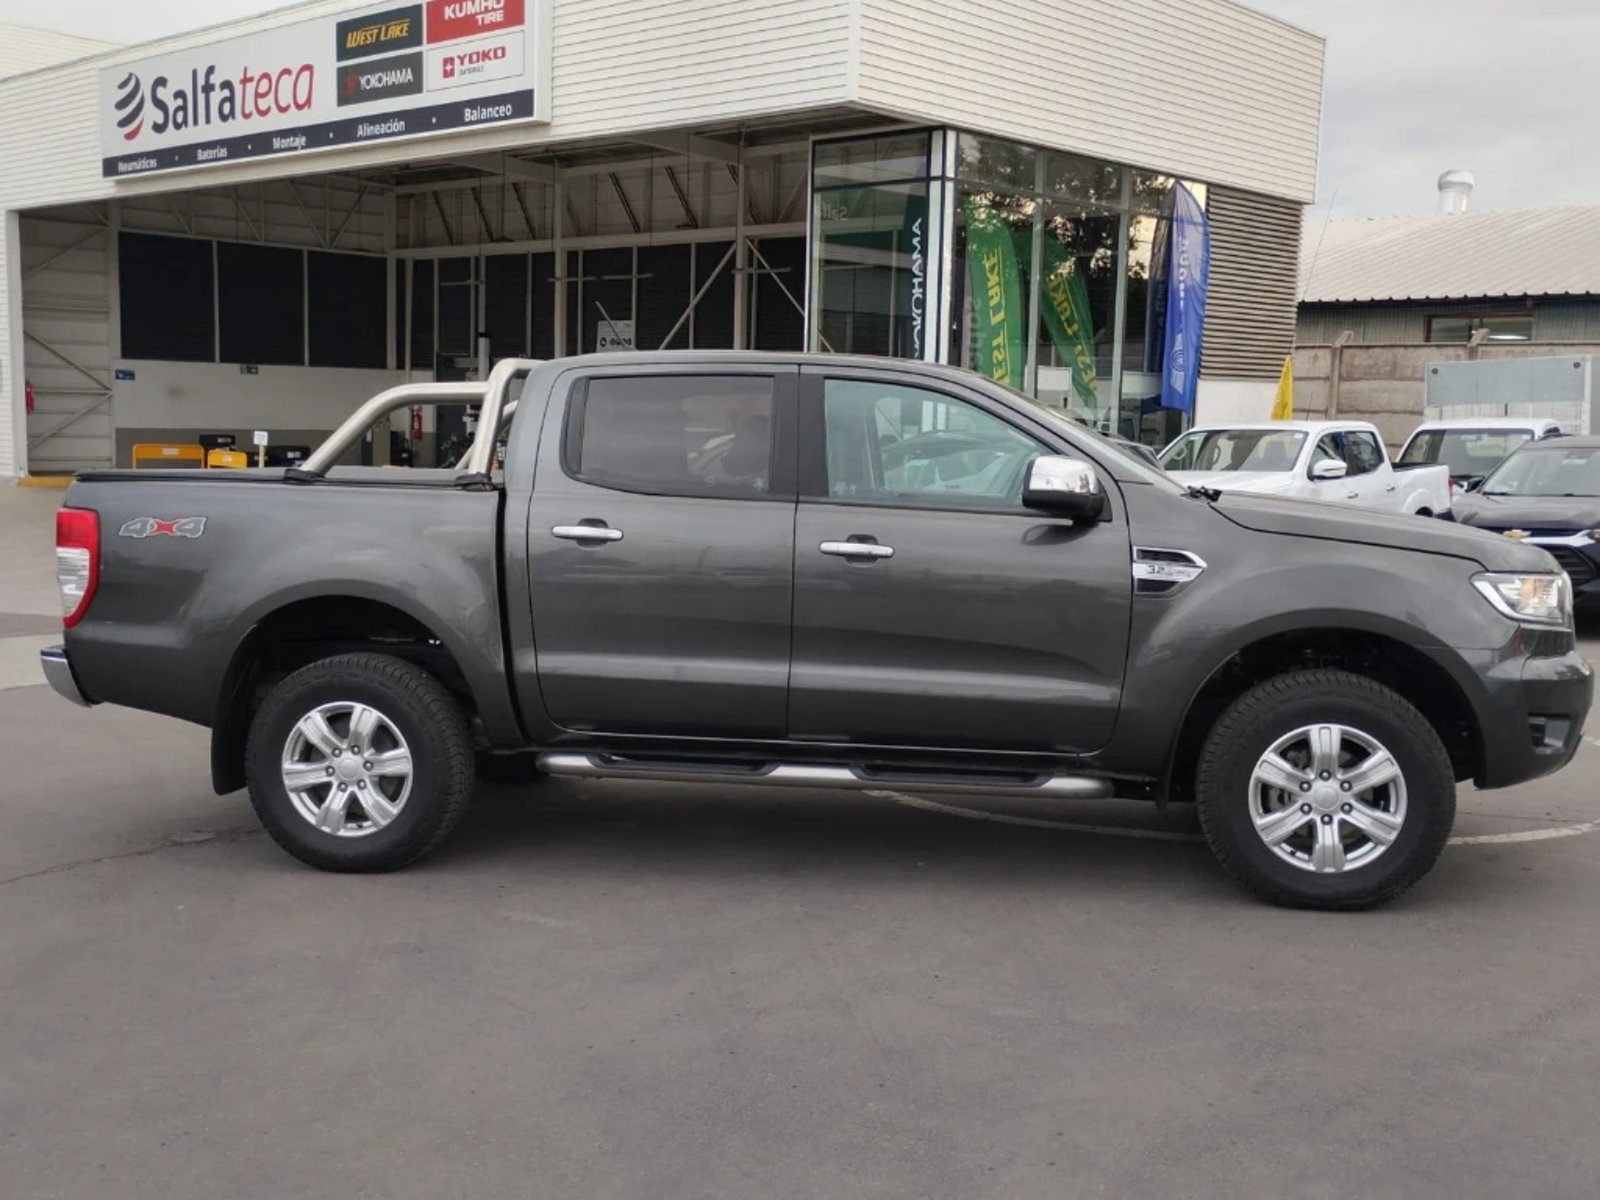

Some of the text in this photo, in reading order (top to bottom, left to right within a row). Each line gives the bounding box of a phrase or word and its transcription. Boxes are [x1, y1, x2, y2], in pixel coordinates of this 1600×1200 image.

[444, 0, 505, 21] KUMHO
[475, 10, 505, 26] TIRE
[346, 18, 411, 49] WEST LAKE
[457, 46, 506, 67] YOKO
[359, 67, 414, 91] YOKOHAMA
[150, 63, 315, 135] Salfateca
[464, 104, 513, 122] Balanceo
[357, 118, 406, 138] Alineación
[197, 145, 228, 160] Baterías
[273, 134, 307, 151] Montaje
[118, 157, 157, 173] Neumáticos
